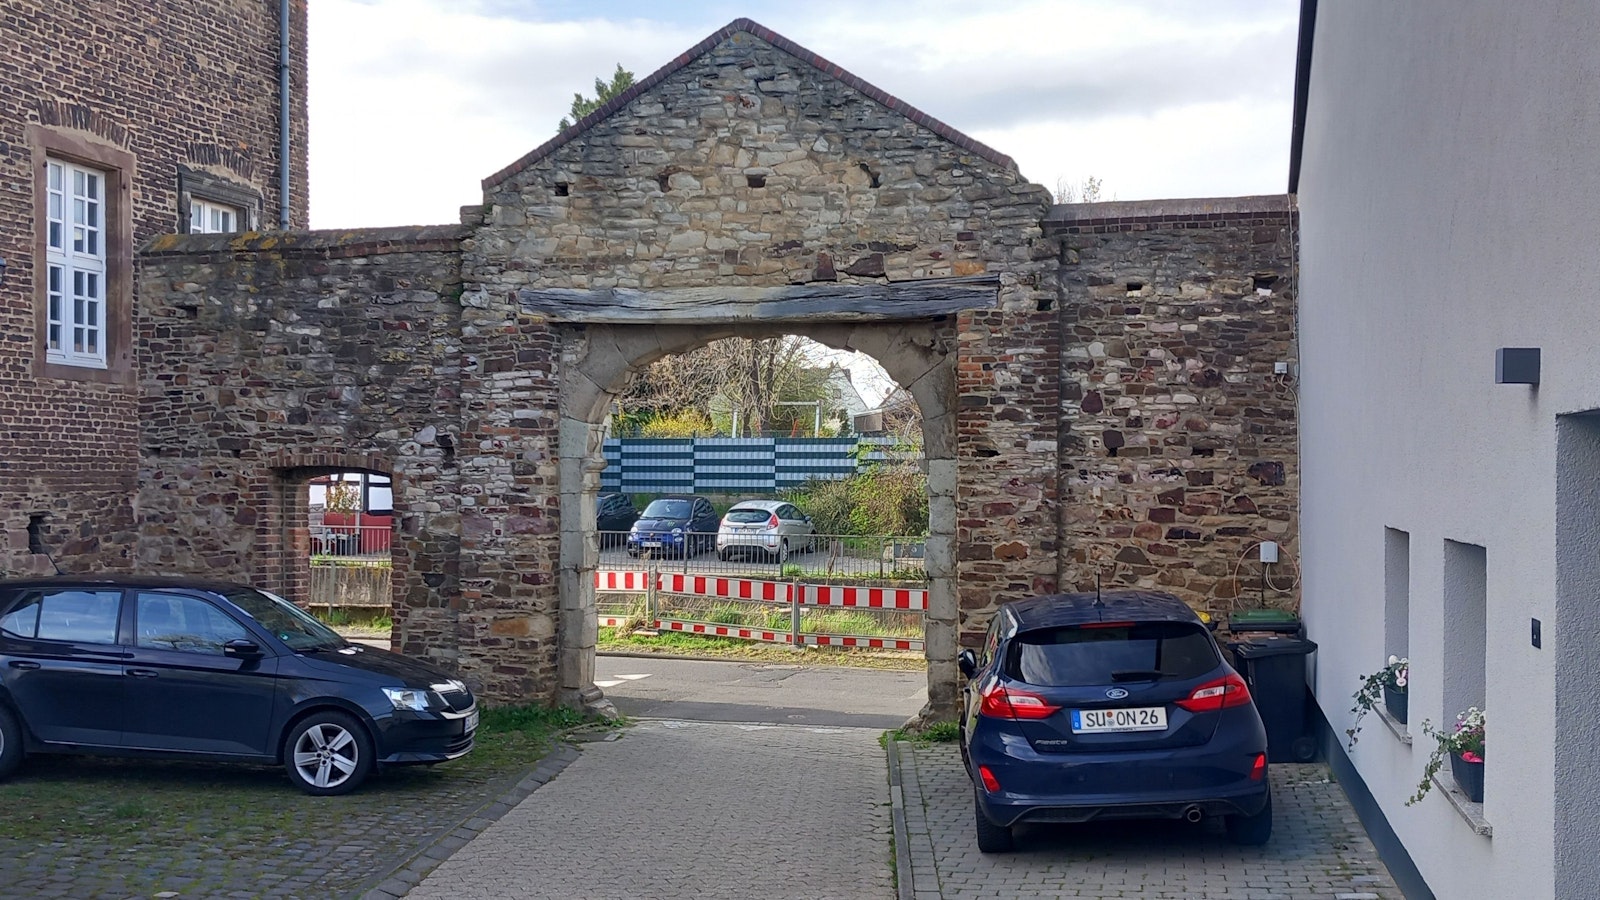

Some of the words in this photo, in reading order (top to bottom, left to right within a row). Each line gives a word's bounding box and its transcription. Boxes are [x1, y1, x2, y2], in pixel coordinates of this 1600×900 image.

[1086, 712, 1106, 727] SU
[1116, 711, 1137, 726] ON
[1139, 709, 1159, 725] 26
